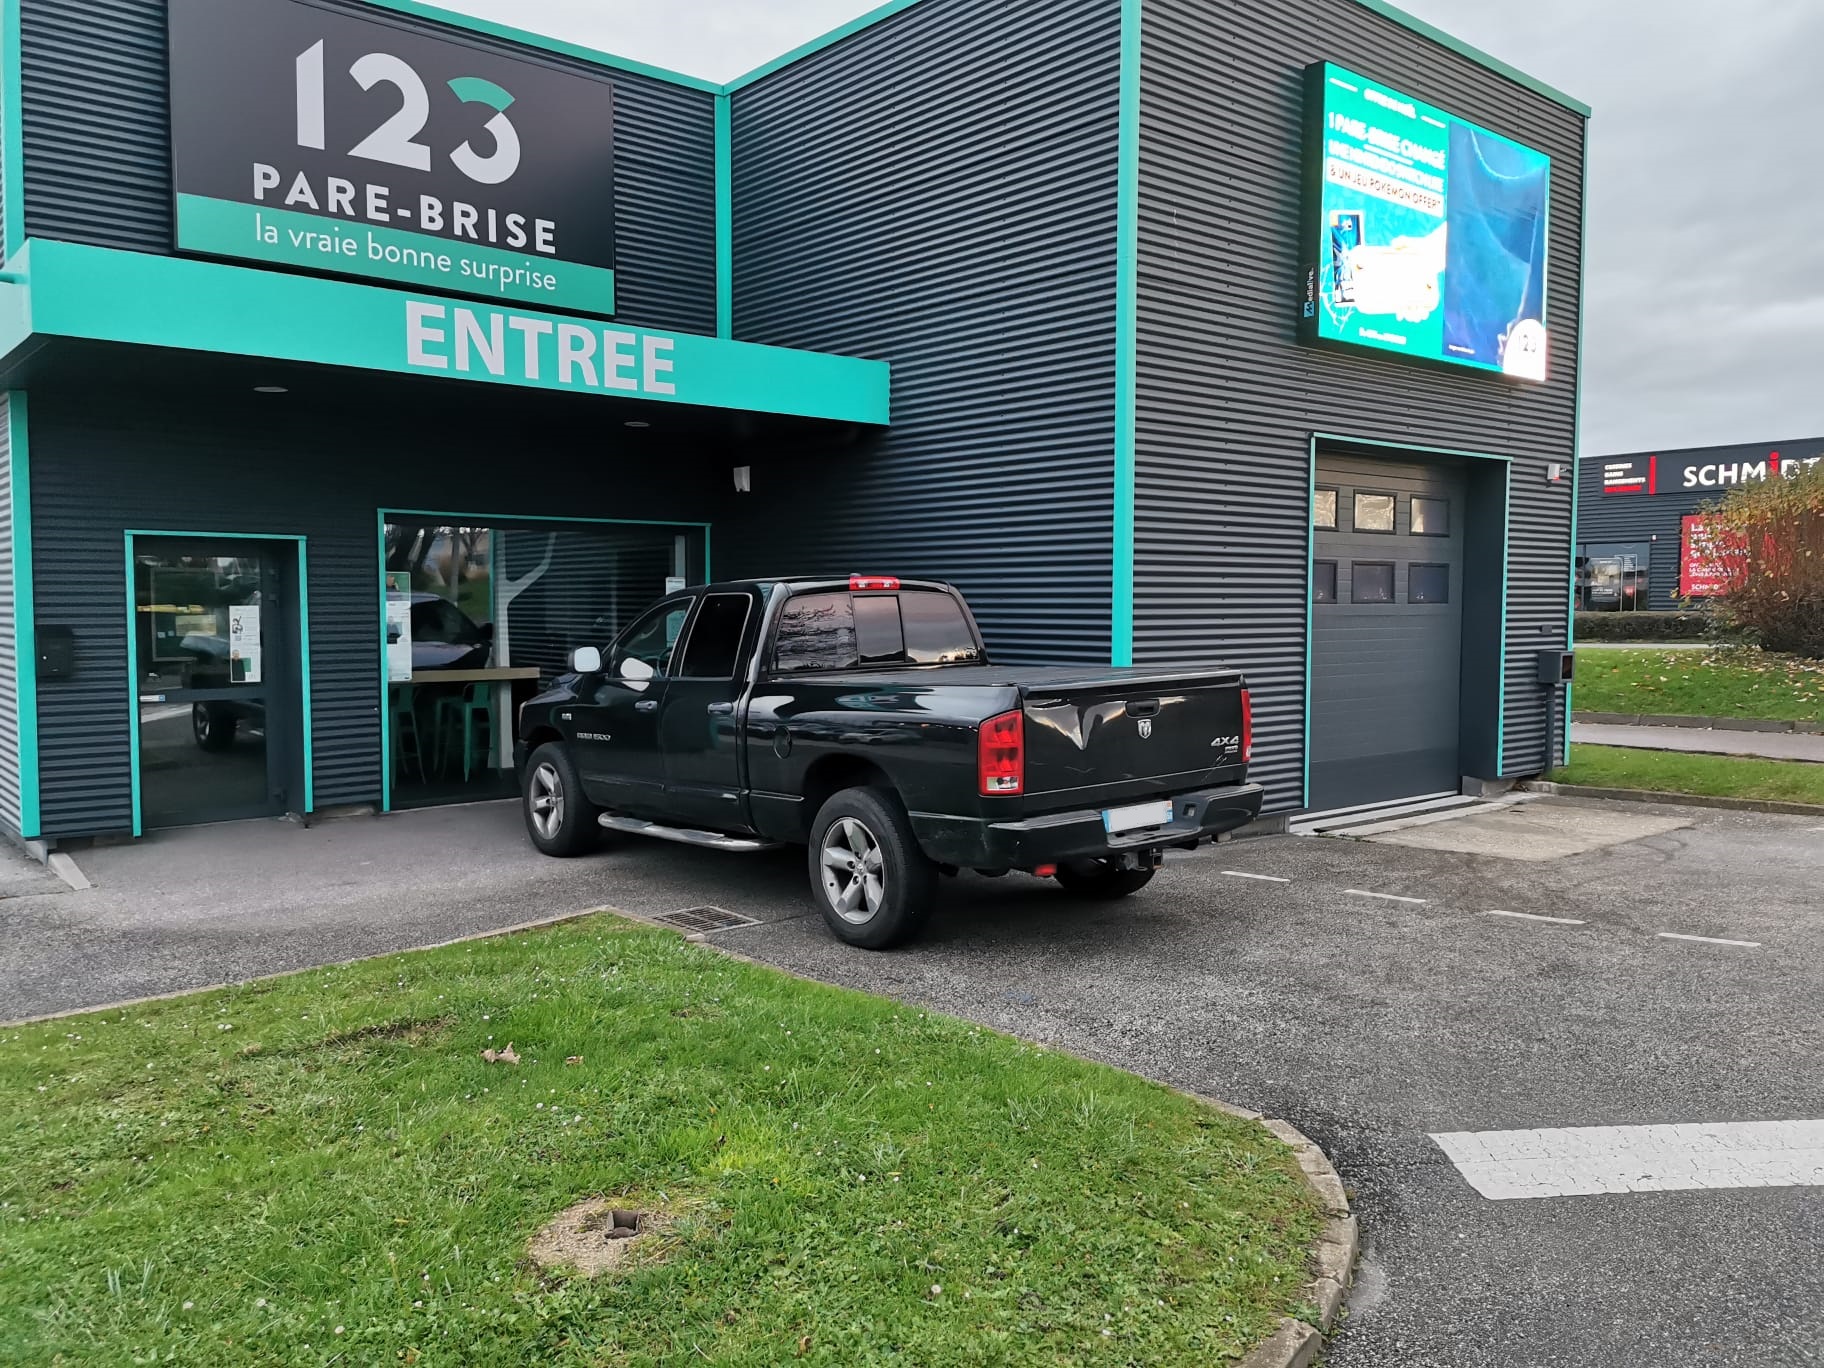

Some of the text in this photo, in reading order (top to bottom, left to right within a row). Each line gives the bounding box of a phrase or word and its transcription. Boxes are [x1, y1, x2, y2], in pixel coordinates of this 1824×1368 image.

[296, 38, 521, 184] 123
[253, 162, 557, 254] PARE-BRISE
[255, 212, 557, 292] la vraie bonne surprise
[406, 300, 676, 395] ENTREE
